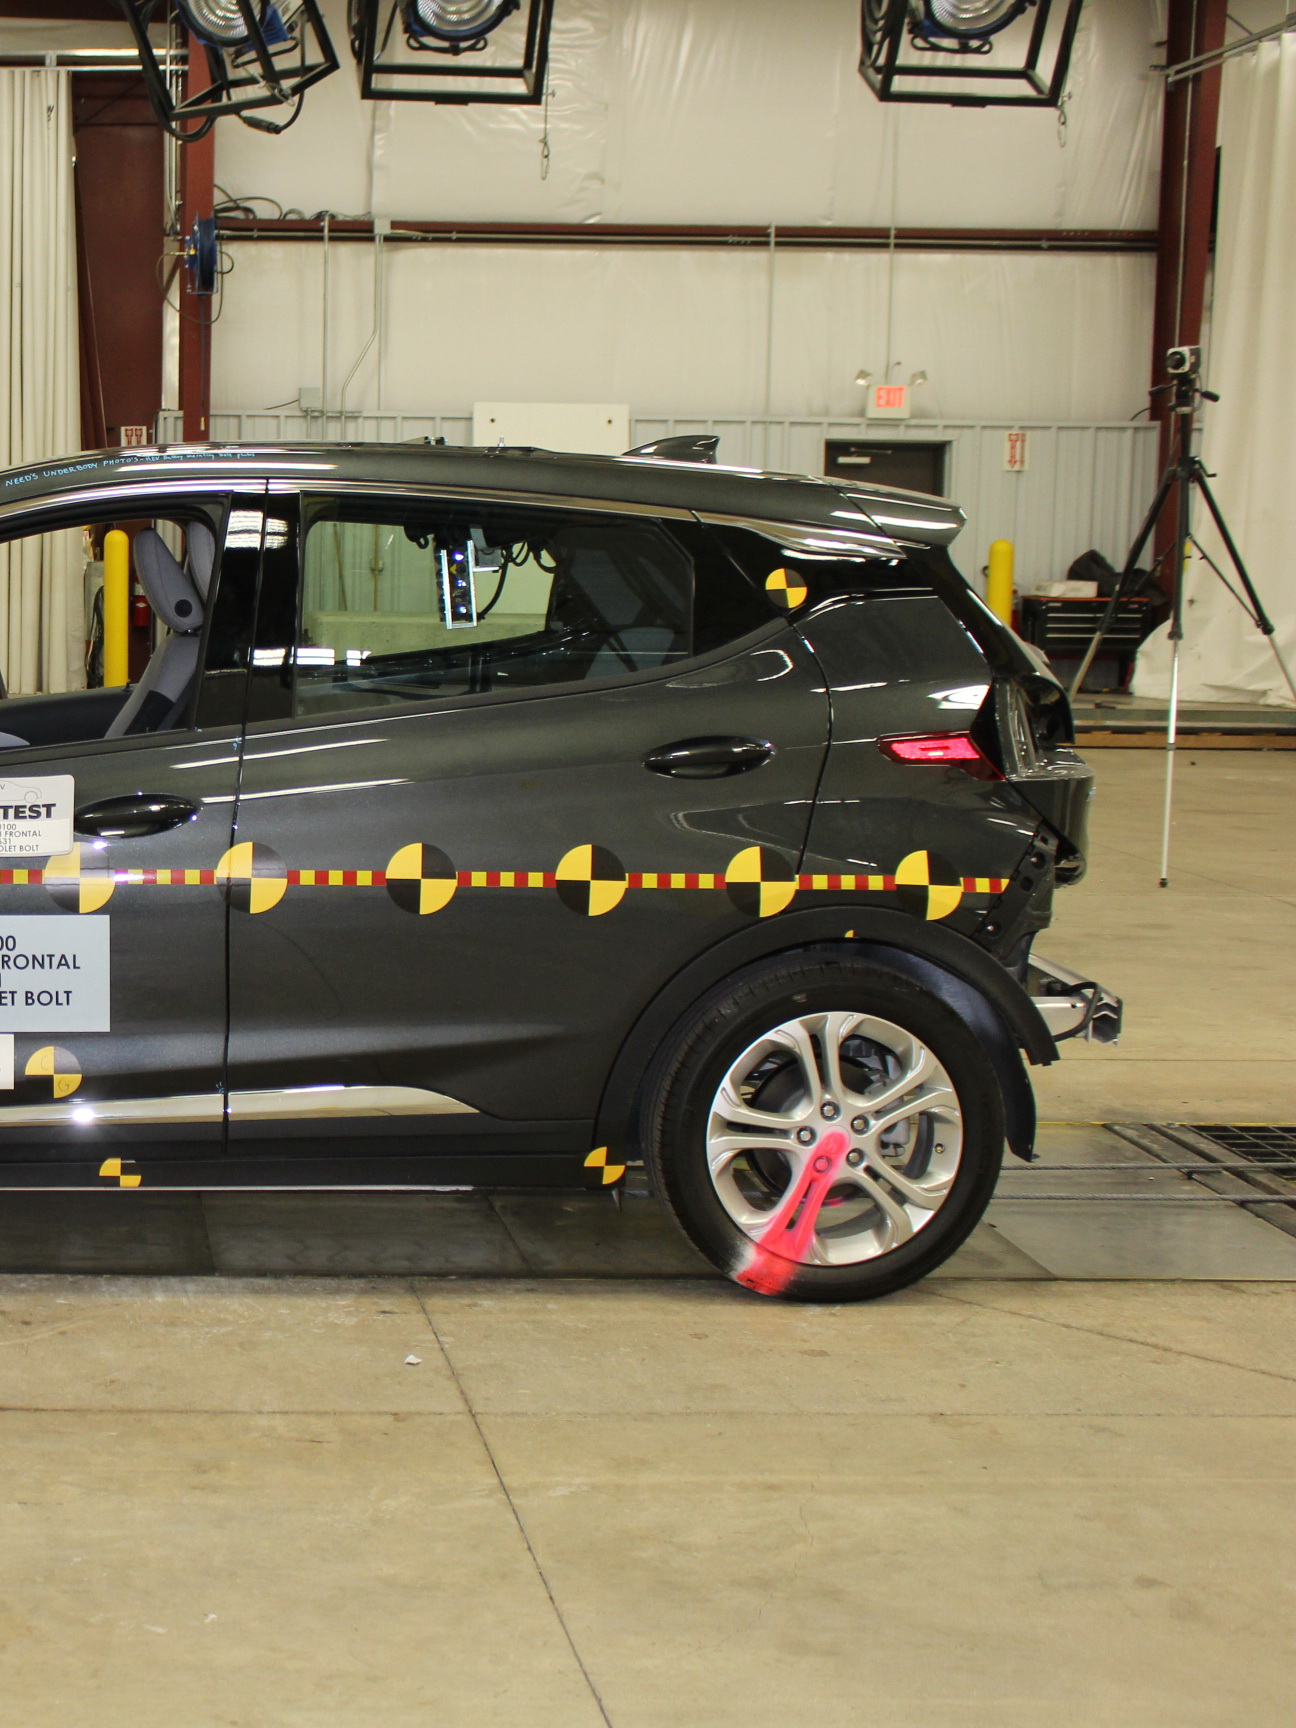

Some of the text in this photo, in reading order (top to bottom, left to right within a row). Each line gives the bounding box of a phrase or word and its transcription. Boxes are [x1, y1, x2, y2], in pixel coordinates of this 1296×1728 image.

[875, 385, 906, 408] EXIT
[5, 473, 39, 487] NEED'S
[43, 463, 98, 477] UNDERBODY
[19, 844, 39, 852] BOLT
[24, 990, 73, 1007] BOLT
